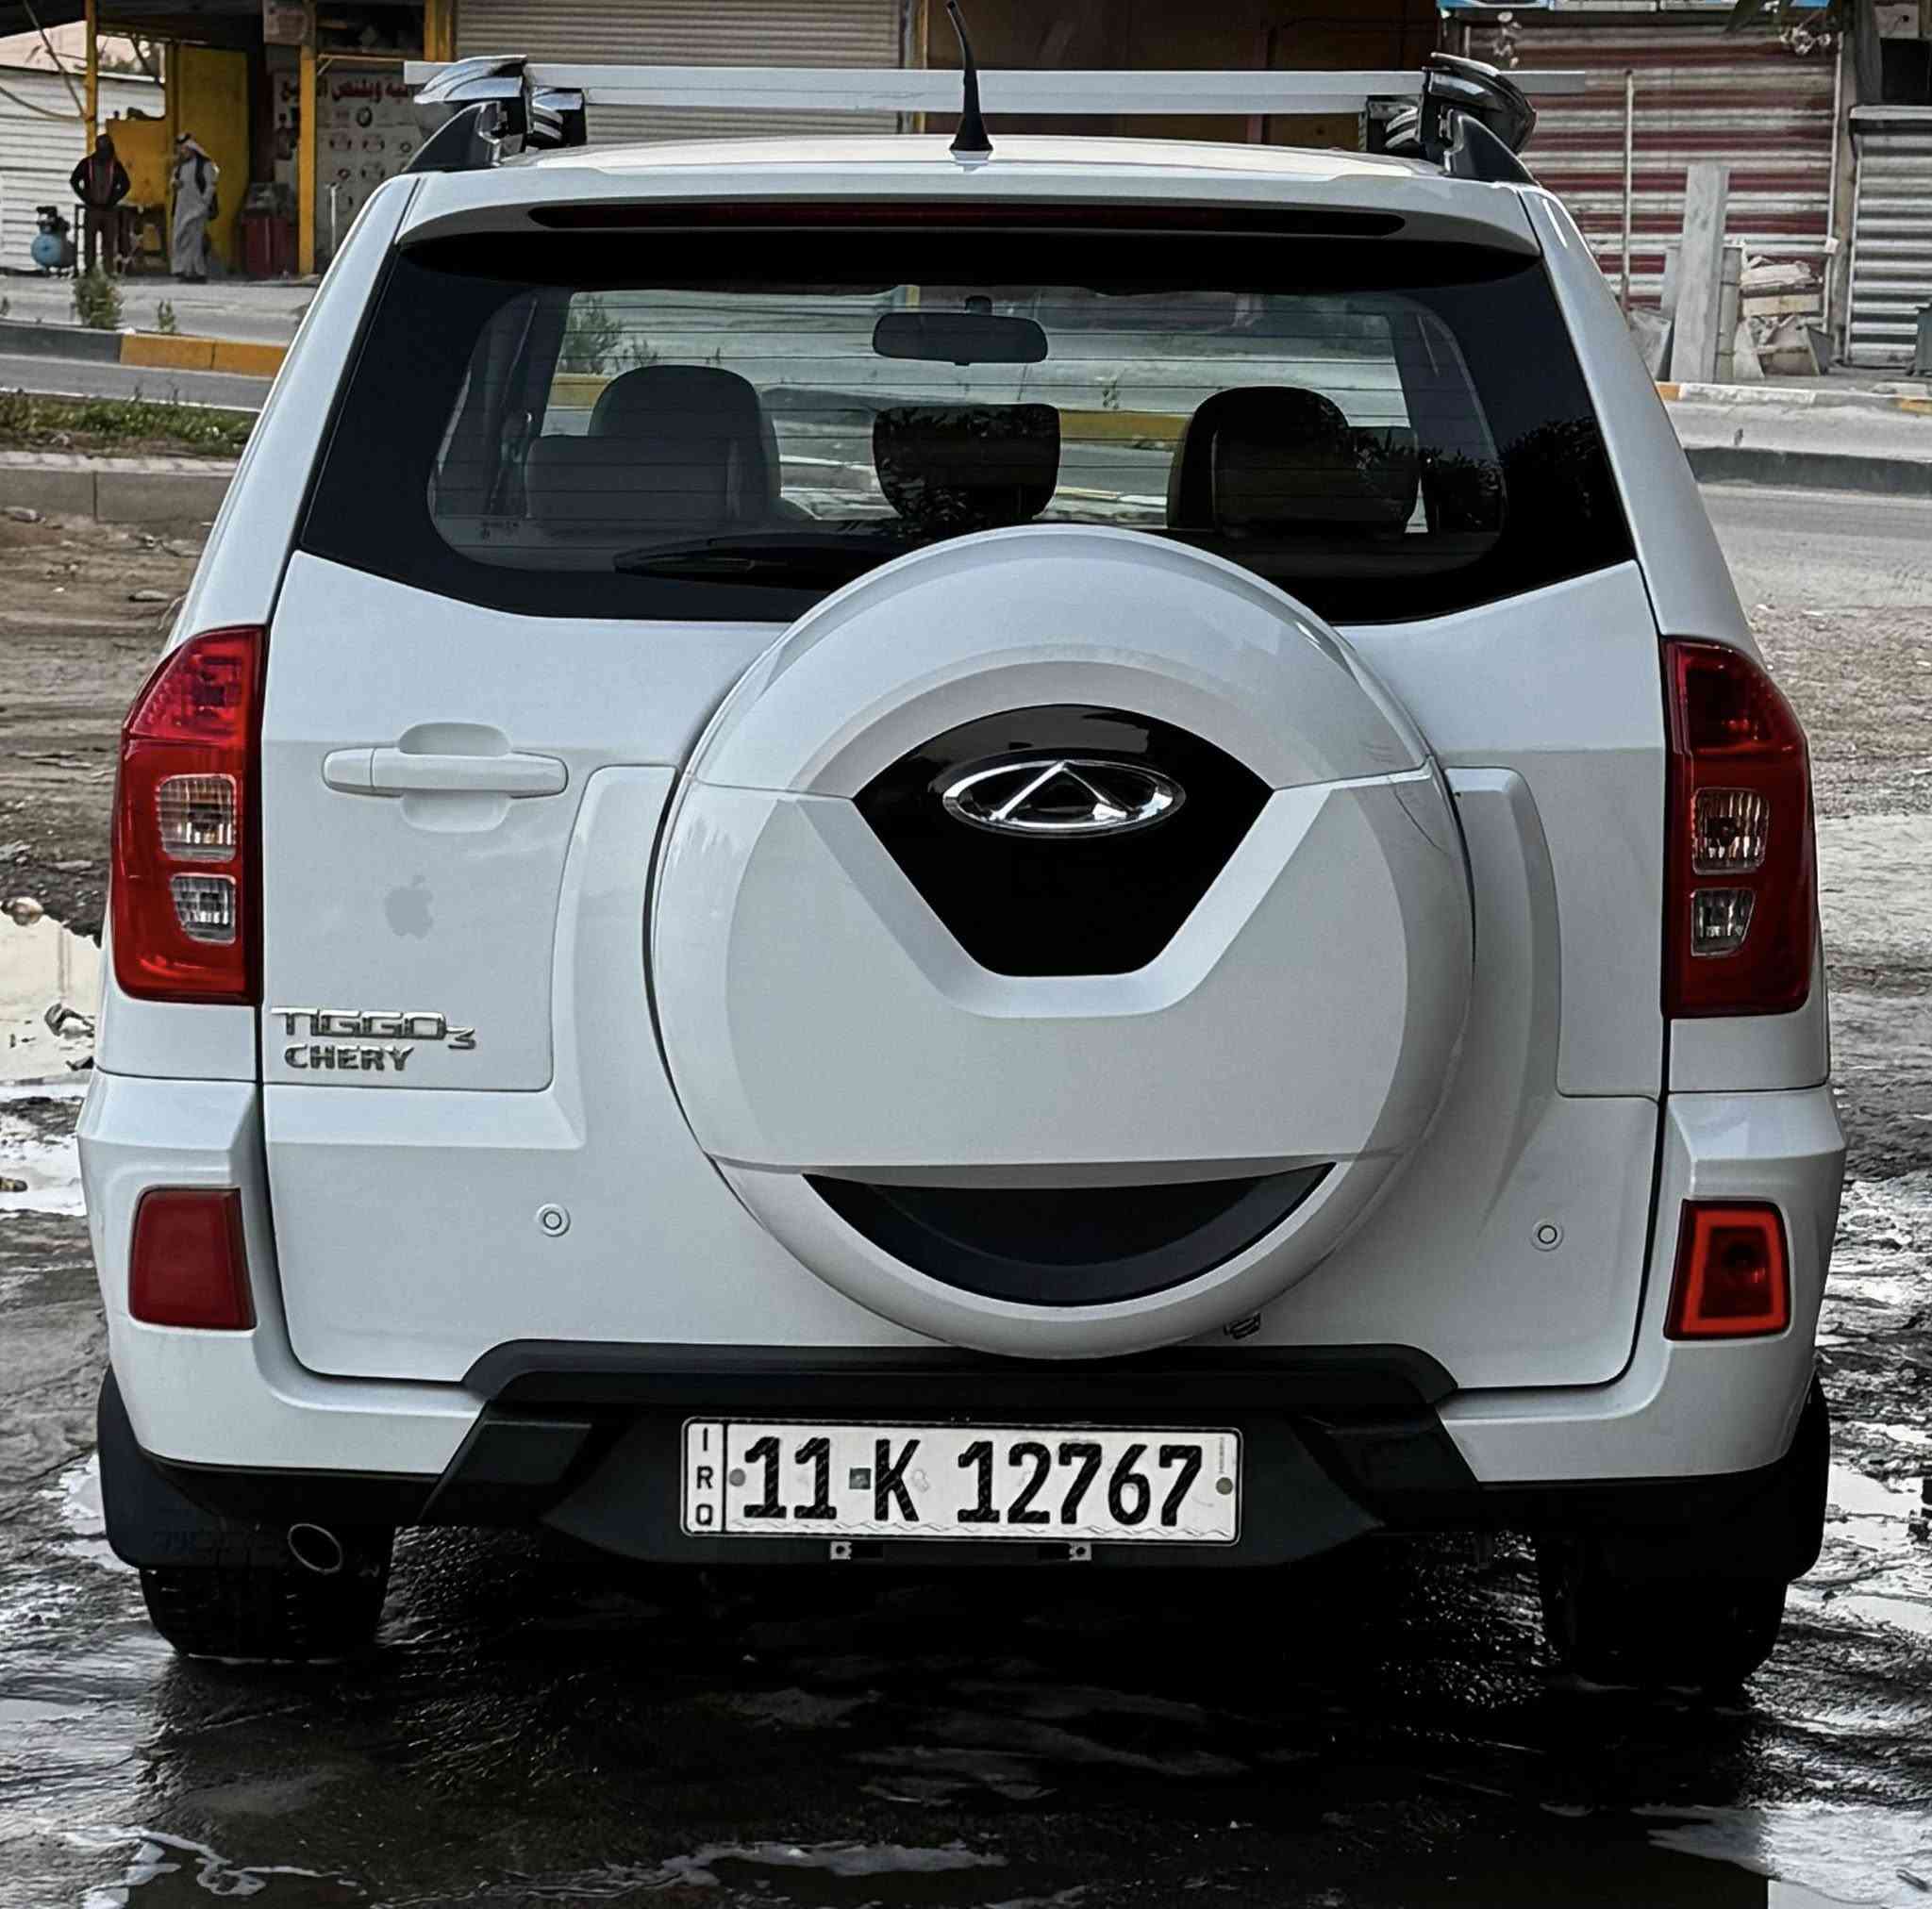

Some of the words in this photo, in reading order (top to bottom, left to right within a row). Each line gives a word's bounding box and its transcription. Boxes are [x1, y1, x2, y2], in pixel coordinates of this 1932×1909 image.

[284, 1044, 414, 1071] CHERY
[743, 1436, 837, 1519] 11
[874, 1438, 921, 1521] K
[958, 1440, 1203, 1527] 12767
